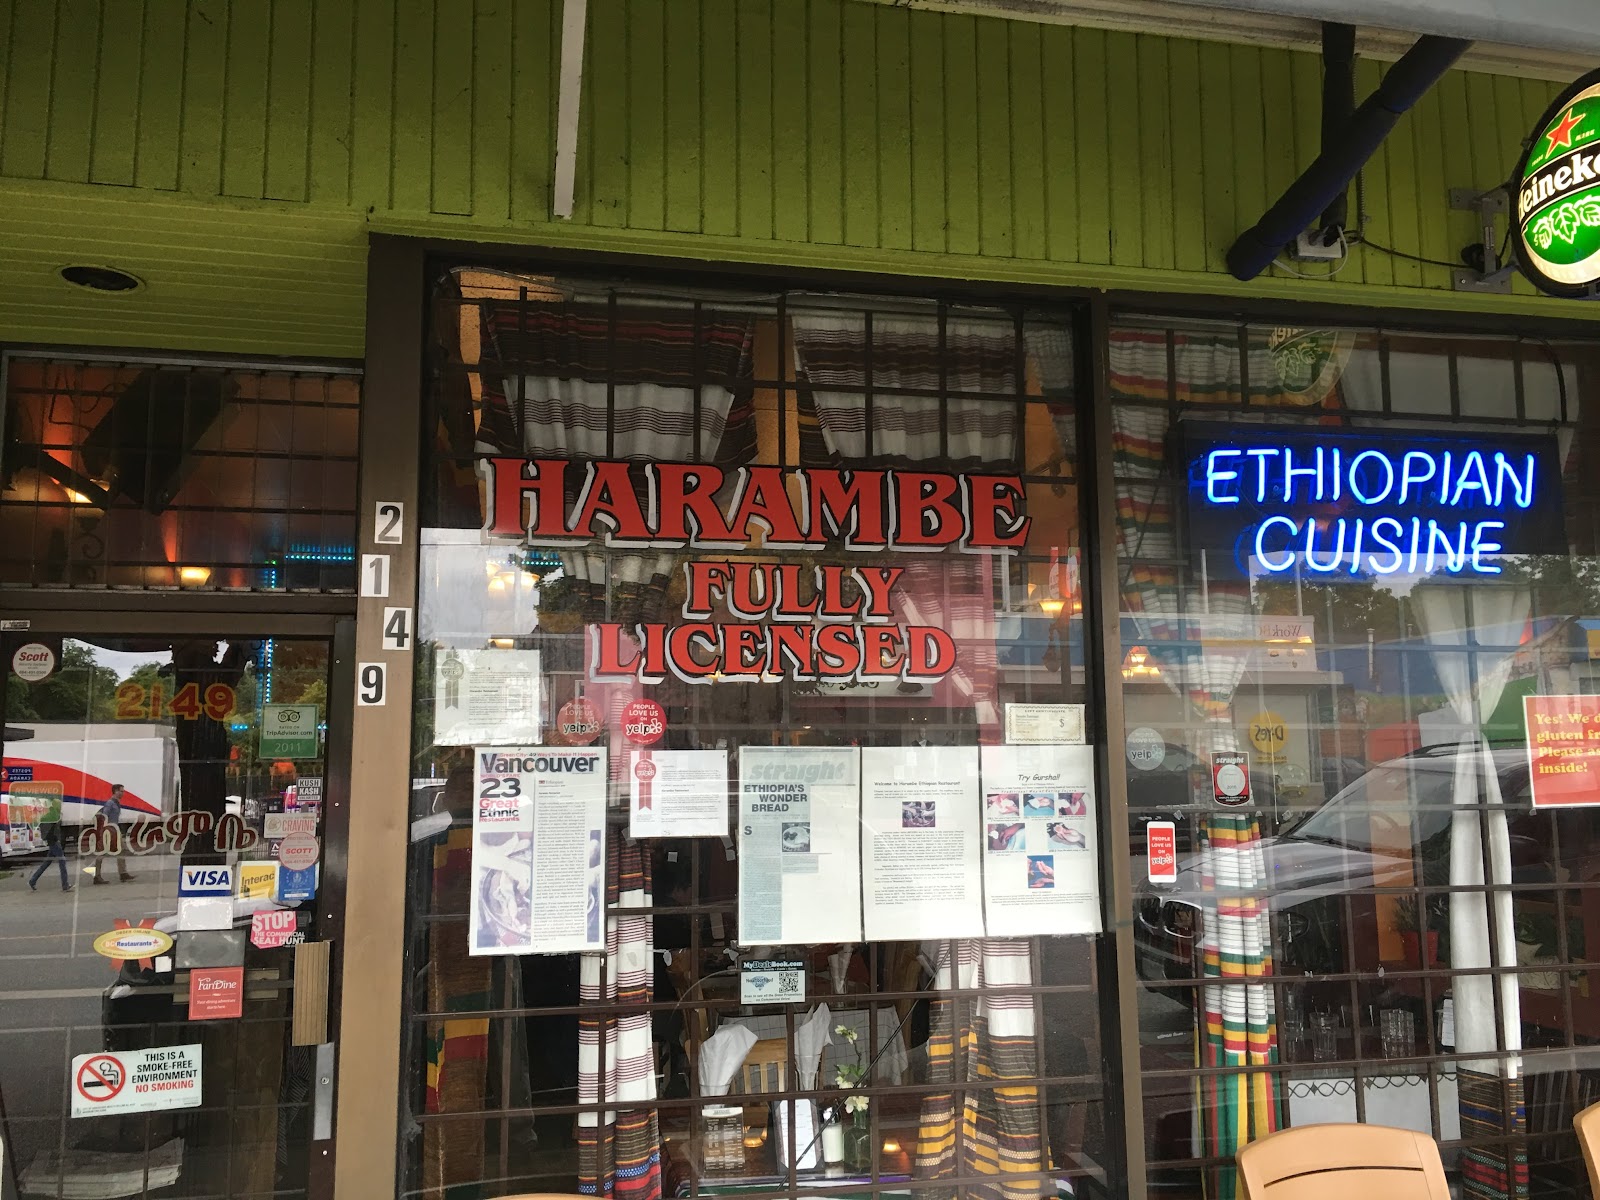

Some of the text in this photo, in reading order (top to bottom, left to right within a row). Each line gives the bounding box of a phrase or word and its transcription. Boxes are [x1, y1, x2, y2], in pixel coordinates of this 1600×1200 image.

[1206, 446, 1535, 508] ETHIOPIAN
[479, 457, 1032, 554] HARAMBE
[378, 505, 400, 542] 2
[1255, 515, 1505, 574] CUISINE
[683, 559, 908, 622] FULLY
[384, 609, 410, 648] 4
[18, 651, 49, 662] Scott
[590, 622, 958, 684] LICENSED
[360, 664, 384, 704] 9
[115, 682, 238, 722] 2149
[629, 709, 648, 717] LOVE
[1534, 713, 1563, 725] Yes!
[1566, 713, 1590, 724] We
[563, 722, 588, 735] yelp
[626, 722, 651, 736] yelp
[1536, 730, 1584, 744] gluten
[274, 742, 301, 753] 2011
[1537, 746, 1584, 757] Please
[1131, 749, 1152, 760] yelp
[1216, 756, 1245, 764] straight
[481, 753, 600, 773] Vancouver
[1538, 762, 1588, 774] inside!
[749, 760, 846, 783] straight
[299, 779, 319, 787] KUSH
[1018, 774, 1030, 783] Try
[15, 786, 59, 794] REVIEWED
[480, 777, 521, 798] 23
[744, 784, 805, 793] ETHIOPIA'S
[479, 797, 519, 809] Great
[759, 793, 808, 803] WONDER
[479, 808, 519, 818] Ethnic
[751, 803, 789, 812] BREAD
[282, 819, 315, 832] CRAVING
[744, 825, 753, 836] S
[285, 847, 314, 855] SCOTT
[1151, 856, 1167, 866] yelp
[185, 870, 230, 886] VISA
[241, 872, 275, 886] Interac
[252, 910, 294, 932] STOP
[105, 940, 115, 948] BC
[253, 936, 306, 945] SEAL HUNT
[197, 977, 238, 991] FanDine
[145, 1050, 185, 1061] THIS IS A
[137, 1060, 193, 1073] SMOKE-FREE
[131, 1069, 198, 1084] ENVIRONMENT
[135, 1079, 194, 1093] NO SMOKING
